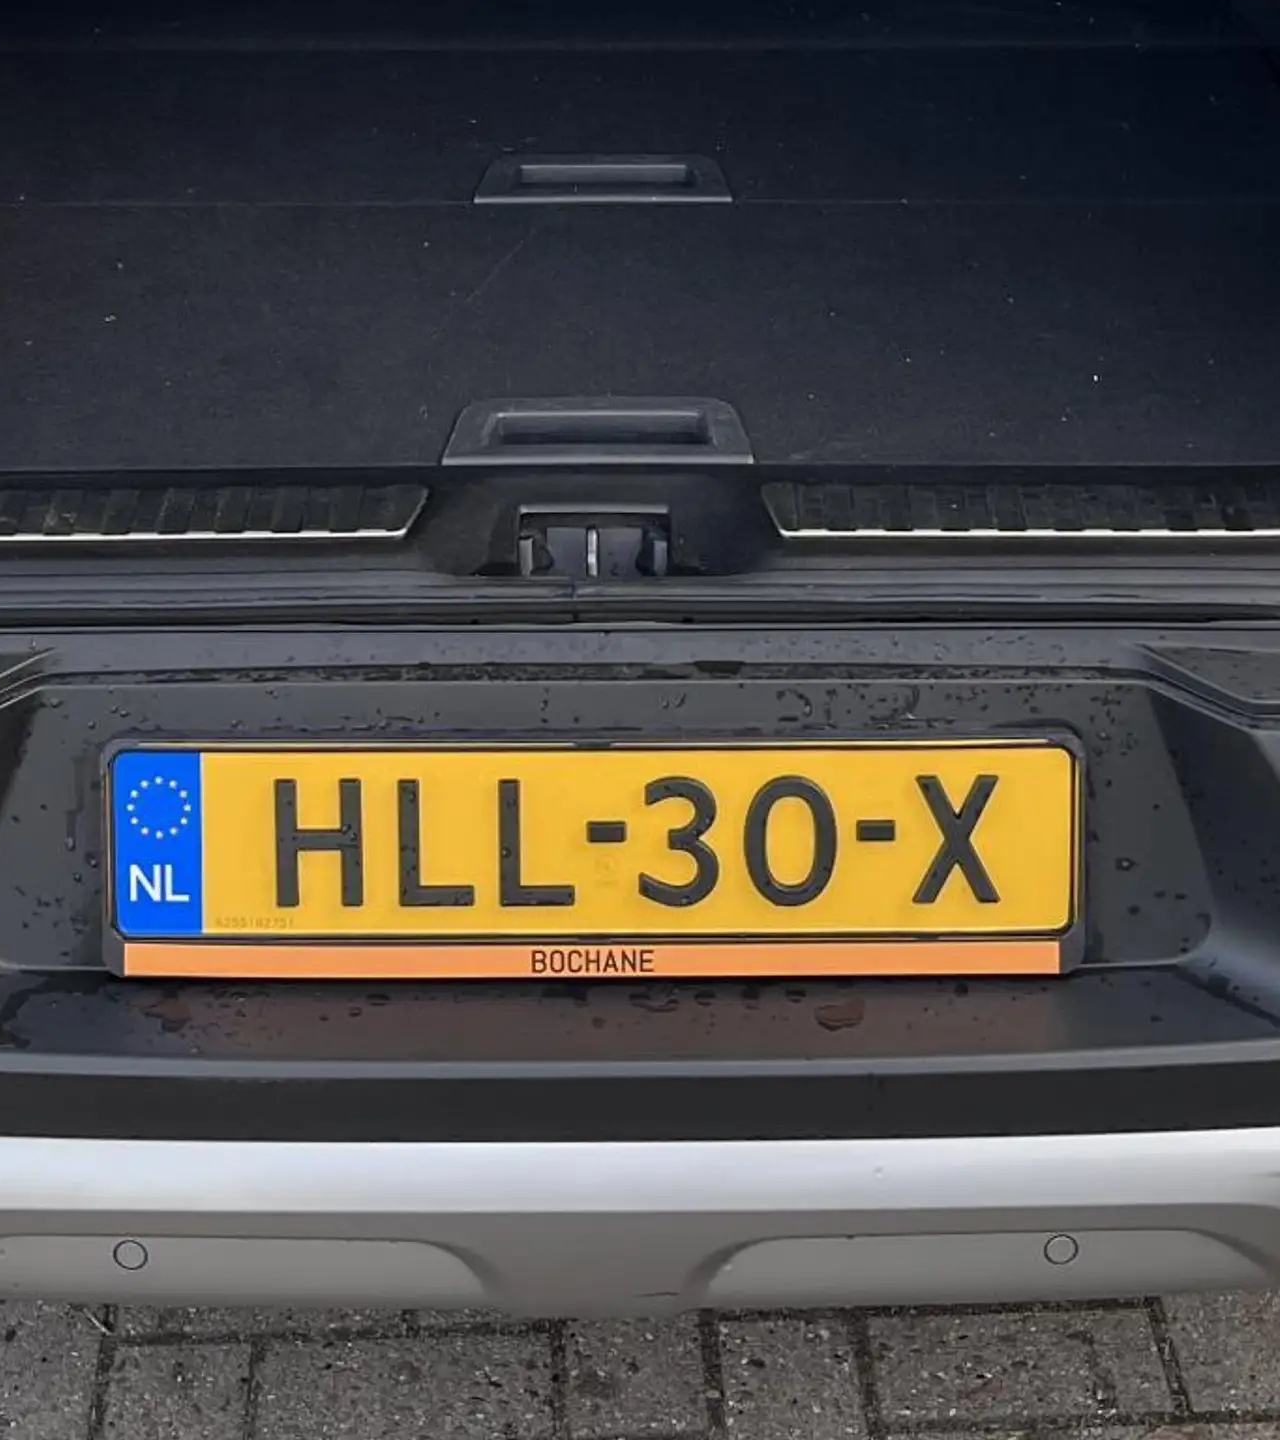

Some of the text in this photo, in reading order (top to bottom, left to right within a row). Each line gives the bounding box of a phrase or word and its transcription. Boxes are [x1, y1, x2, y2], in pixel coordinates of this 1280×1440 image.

[274, 774, 1001, 907] HLL-30-X
[130, 864, 190, 902] NL
[531, 949, 655, 973] BOCHANE
